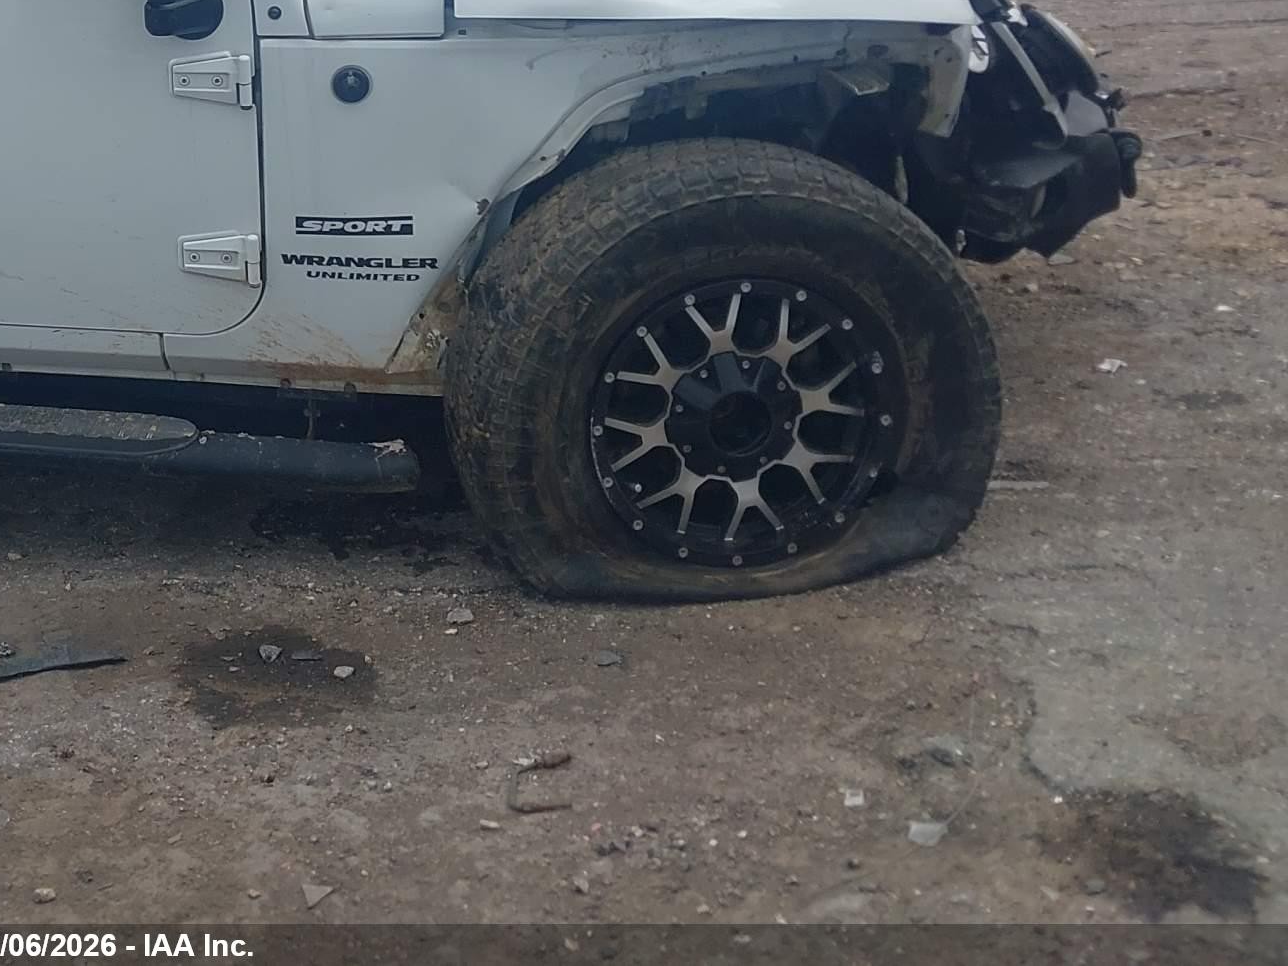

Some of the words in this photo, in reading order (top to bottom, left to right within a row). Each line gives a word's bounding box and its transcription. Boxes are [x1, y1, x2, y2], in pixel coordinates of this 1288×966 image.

[296, 219, 414, 233] SPORT
[280, 253, 439, 269] WRANGLER
[306, 270, 421, 282] UNLIMITED
